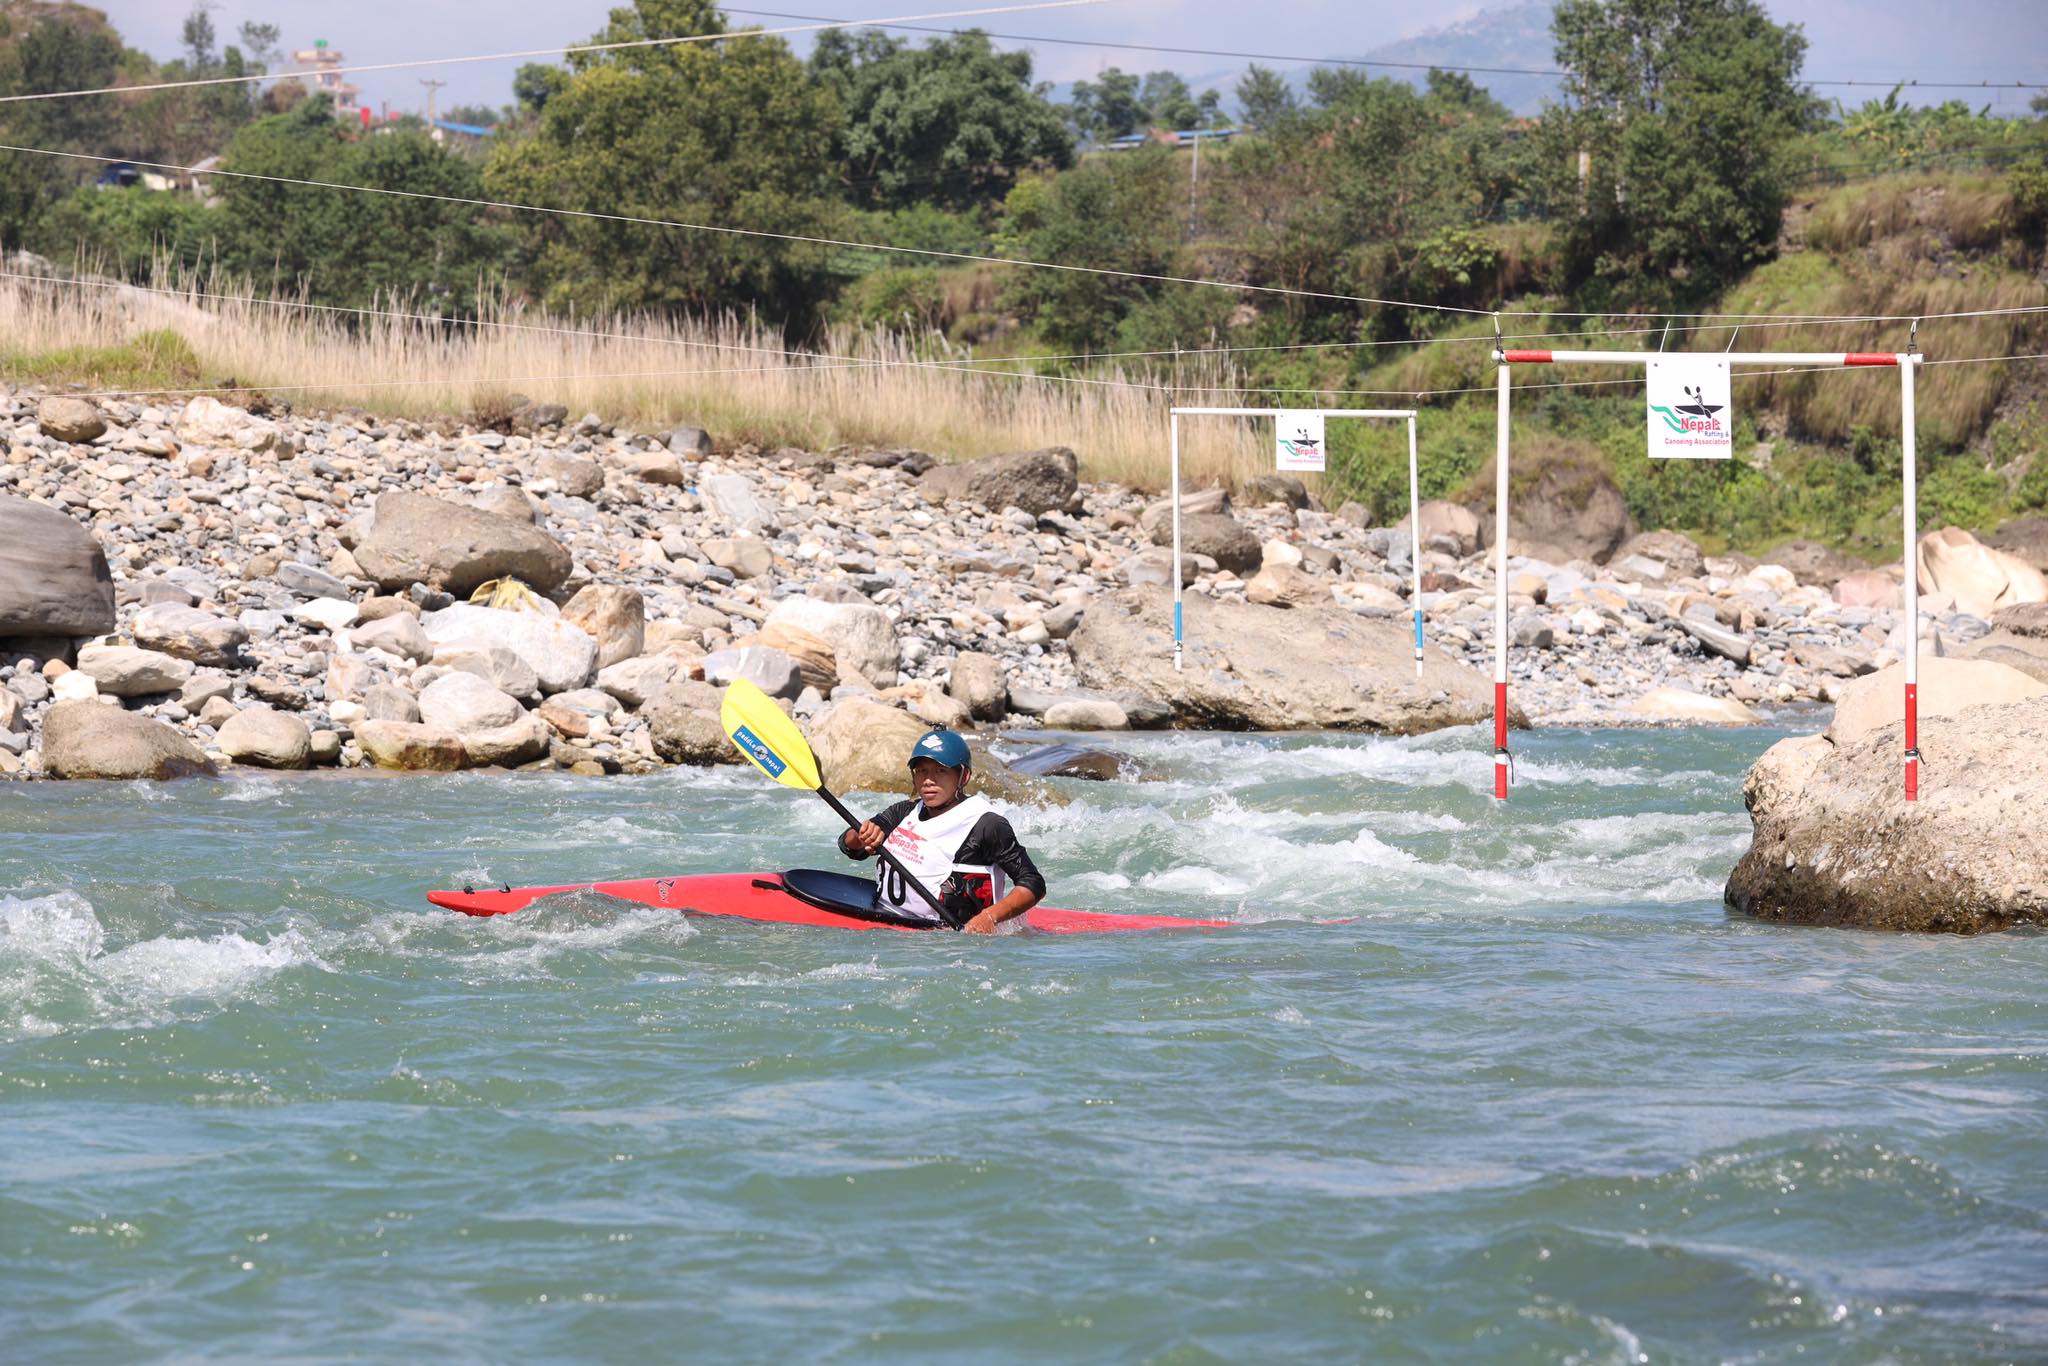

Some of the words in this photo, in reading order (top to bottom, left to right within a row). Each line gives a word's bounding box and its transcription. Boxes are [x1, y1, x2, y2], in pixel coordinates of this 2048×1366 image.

[1681, 418, 1721, 433] Nepal
[1664, 438, 1693, 446] Canoeing
[890, 833, 919, 852] Nepal
